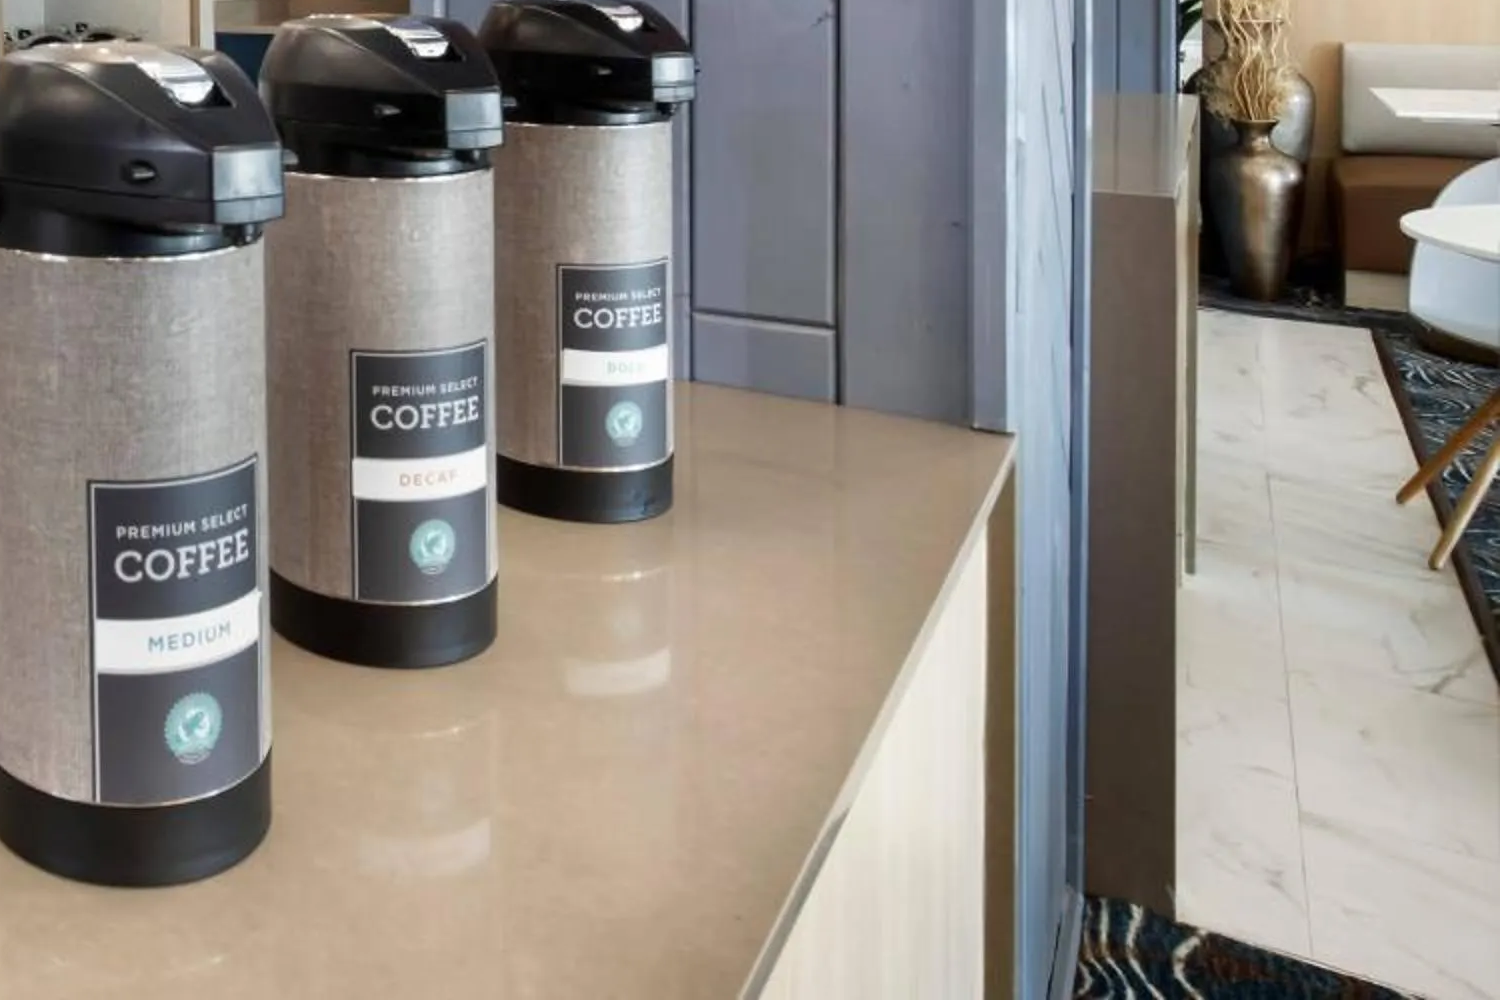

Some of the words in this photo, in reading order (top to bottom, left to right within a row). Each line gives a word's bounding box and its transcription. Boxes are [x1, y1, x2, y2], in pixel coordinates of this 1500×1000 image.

[573, 302, 663, 329] COFFEE
[371, 383, 436, 398] PREMIUM
[439, 376, 478, 395] SELECT
[370, 396, 480, 430] COFFEE
[399, 469, 458, 488] DECAF
[115, 519, 197, 540] PREMIUM
[201, 503, 249, 532] SELECT
[113, 527, 250, 584] COFFEE
[148, 620, 233, 653] MEDIUM
